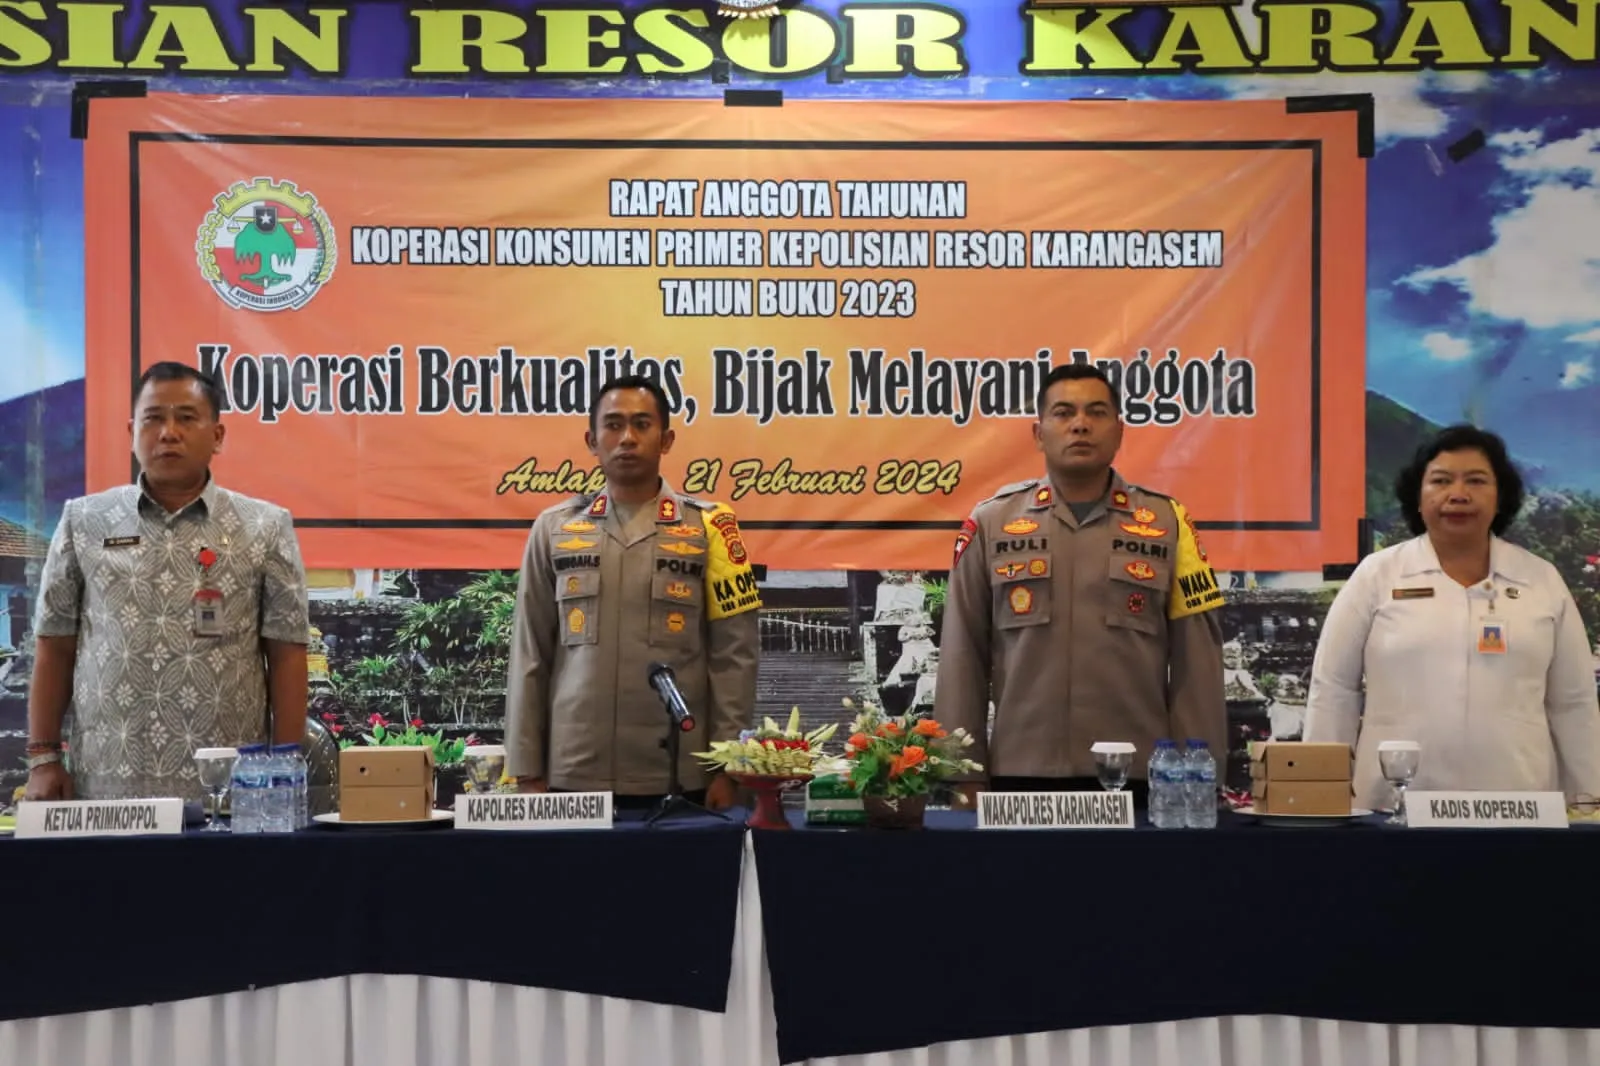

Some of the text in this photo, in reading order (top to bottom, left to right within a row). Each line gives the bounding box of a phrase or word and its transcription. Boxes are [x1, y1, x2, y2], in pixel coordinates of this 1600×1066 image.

[411, 5, 963, 74] RESOR
[1025, 0, 1598, 70] KARAN
[610, 179, 967, 219] RAPAT ANGGOTA TAHUNAN
[351, 226, 1223, 269] KOPERASI KONSUMEN PRIMER KEPOLISIAN RESOR KARANGASEM
[660, 279, 916, 317] TAHUN BUKU 2023
[197, 344, 409, 423] Koperasi
[712, 348, 835, 426] Bijak
[1068, 348, 1257, 427] nggota
[496, 457, 960, 500] Amlap 21 Februari 2024
[996, 538, 1048, 554] RULI
[1112, 538, 1168, 559] POLRI
[656, 557, 704, 578] POLRI
[712, 577, 736, 602] KA
[1178, 568, 1213, 598] WAKA
[44, 804, 158, 833] KETUA PRIMKOPPOL
[467, 794, 605, 823] KAPOLRES KARANGASEM
[982, 794, 1129, 826] WAKAPOLRES KARANGASEM
[1430, 799, 1539, 820] KADIS KOPERASI
